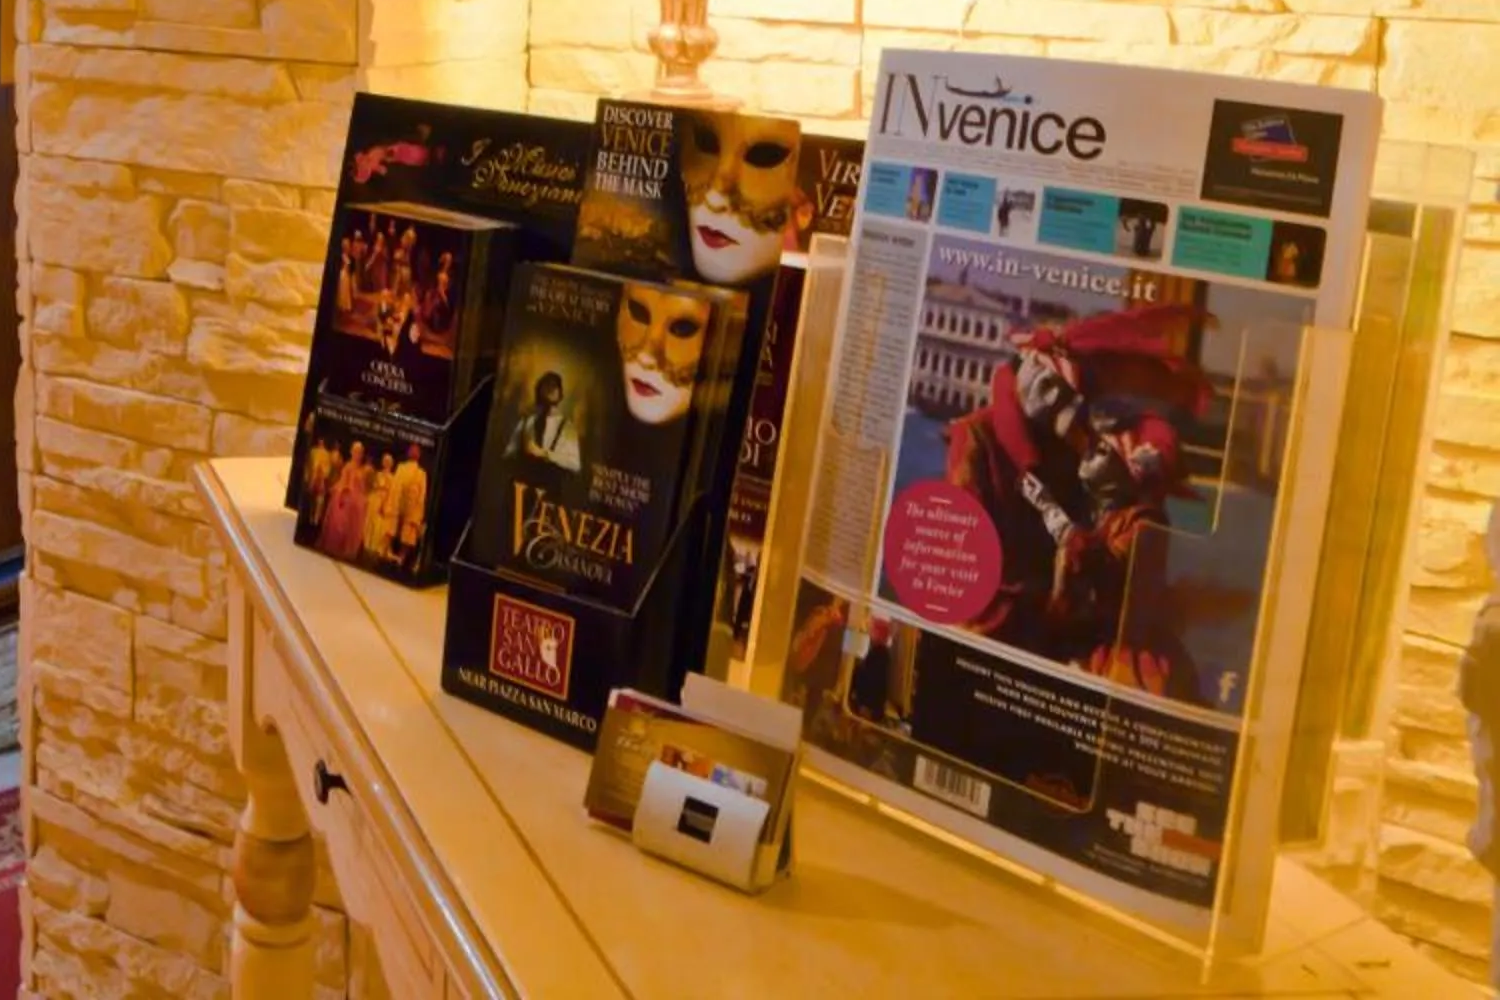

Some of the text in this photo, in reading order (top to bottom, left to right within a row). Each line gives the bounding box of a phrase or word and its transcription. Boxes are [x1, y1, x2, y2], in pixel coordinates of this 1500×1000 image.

[603, 105, 673, 131] DISCOVER
[602, 123, 673, 157] VENICE
[596, 151, 669, 180] BEHIND
[594, 171, 663, 200] THE MASK
[939, 244, 1158, 302] www.in-venice.it
[513, 481, 634, 565] VENEZIA
[905, 501, 925, 518] The
[903, 537, 977, 563] information
[502, 604, 565, 644] TEATRO
[502, 628, 536, 657] SAN
[497, 646, 561, 688] GALLO
[458, 666, 597, 732] NEAR PIAZZA SAN MARCO
